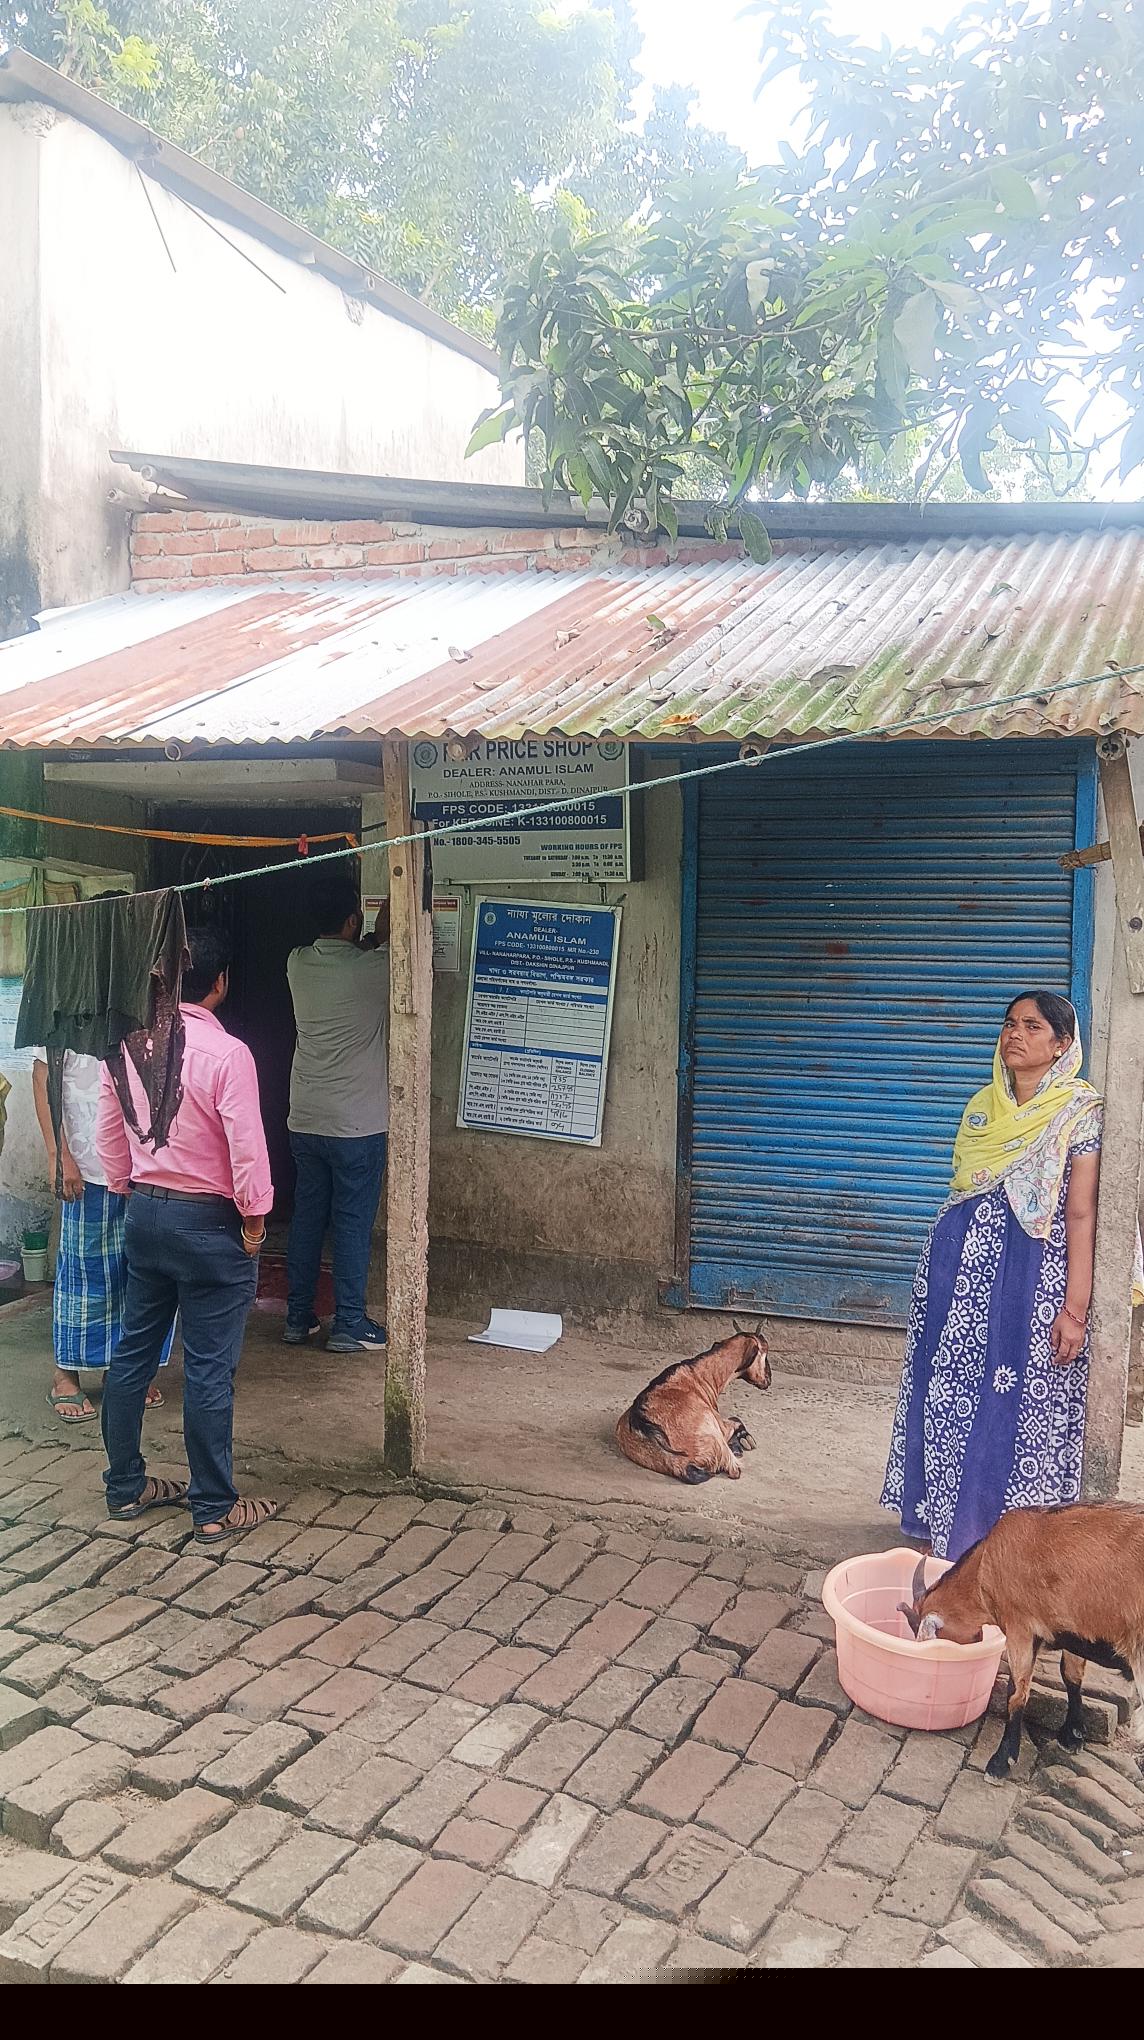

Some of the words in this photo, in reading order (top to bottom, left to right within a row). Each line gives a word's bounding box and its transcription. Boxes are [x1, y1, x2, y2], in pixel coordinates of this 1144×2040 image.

[486, 740, 538, 760] PRICE
[543, 740, 593, 758] SHOP
[443, 767, 496, 778] DEALER:
[499, 766, 552, 777] ANAMUL
[555, 763, 594, 774] ISLAM
[506, 779, 544, 787] NANAHAR
[545, 778, 566, 787] PARA,
[489, 787, 537, 797] KUSHMANDI,
[442, 805, 466, 815] FPS
[469, 803, 508, 814] CODE:
[431, 818, 450, 829] For
[517, 814, 607, 827] K-133100800015
[561, 913, 592, 925] দোকান
[533, 926, 558, 934] DEALER-
[506, 931, 551, 942] ANAMUL
[554, 935, 587, 946] ISLAM
